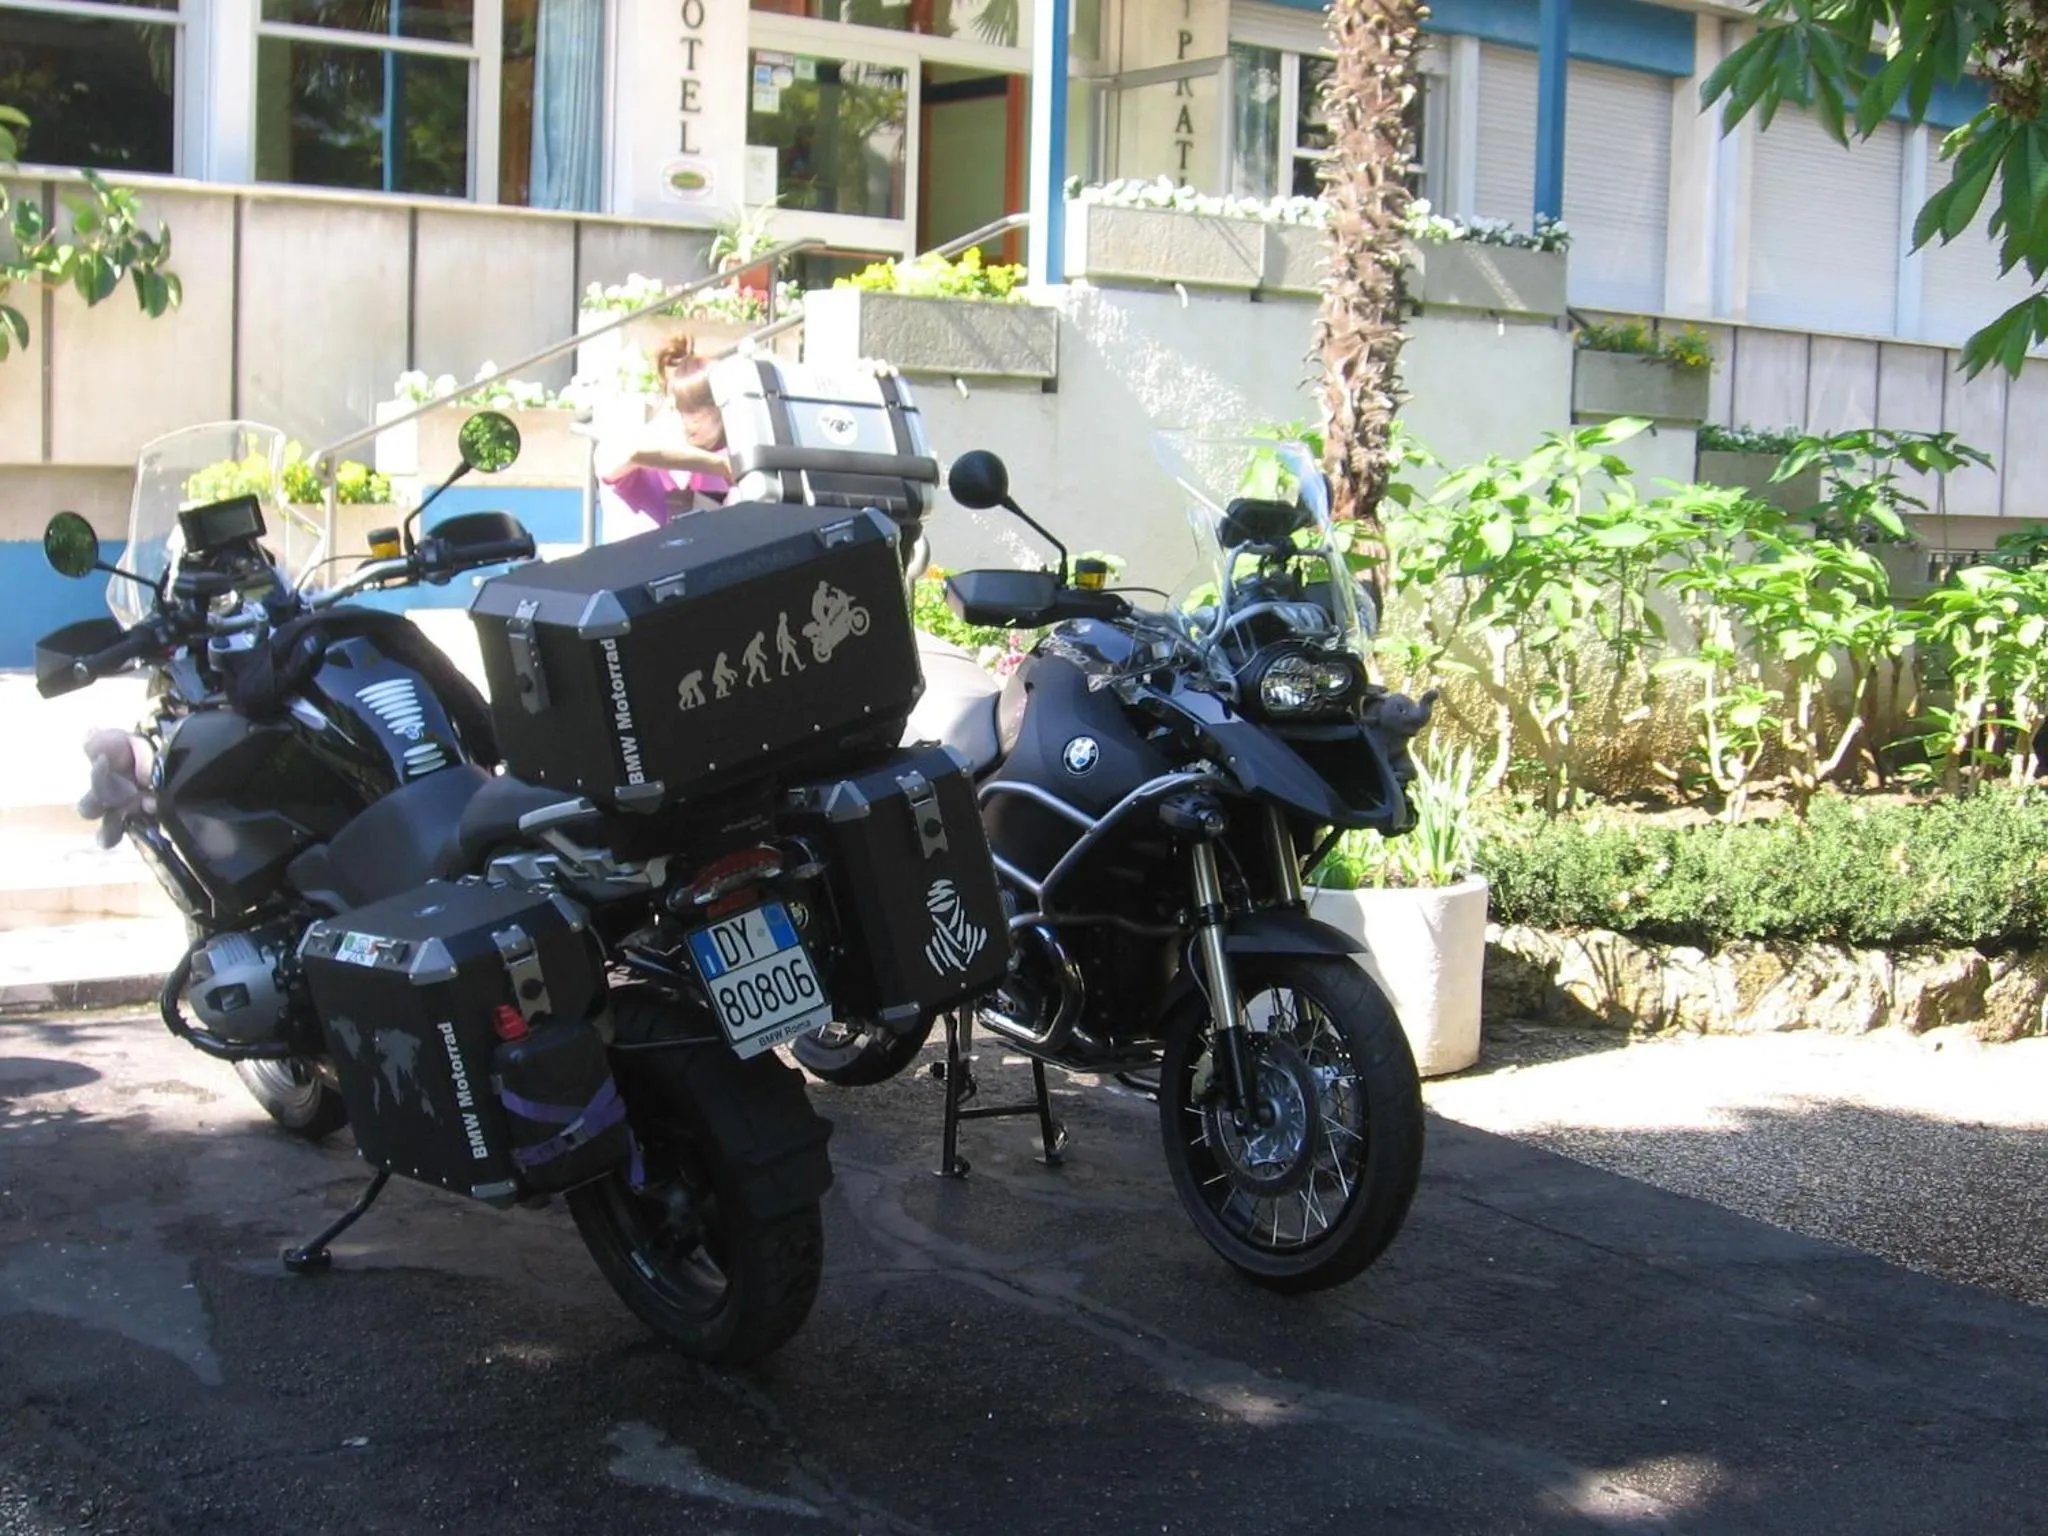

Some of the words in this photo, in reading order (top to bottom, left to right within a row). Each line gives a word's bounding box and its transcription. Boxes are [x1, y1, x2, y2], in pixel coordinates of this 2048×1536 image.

[601, 638, 633, 730] Motorrad
[620, 736, 646, 786] BMW
[712, 917, 755, 968] DY
[719, 958, 816, 1028] 80806
[757, 1030, 784, 1047] BMW
[436, 1021, 475, 1108] Motorrad
[462, 1113, 489, 1160] BMW
